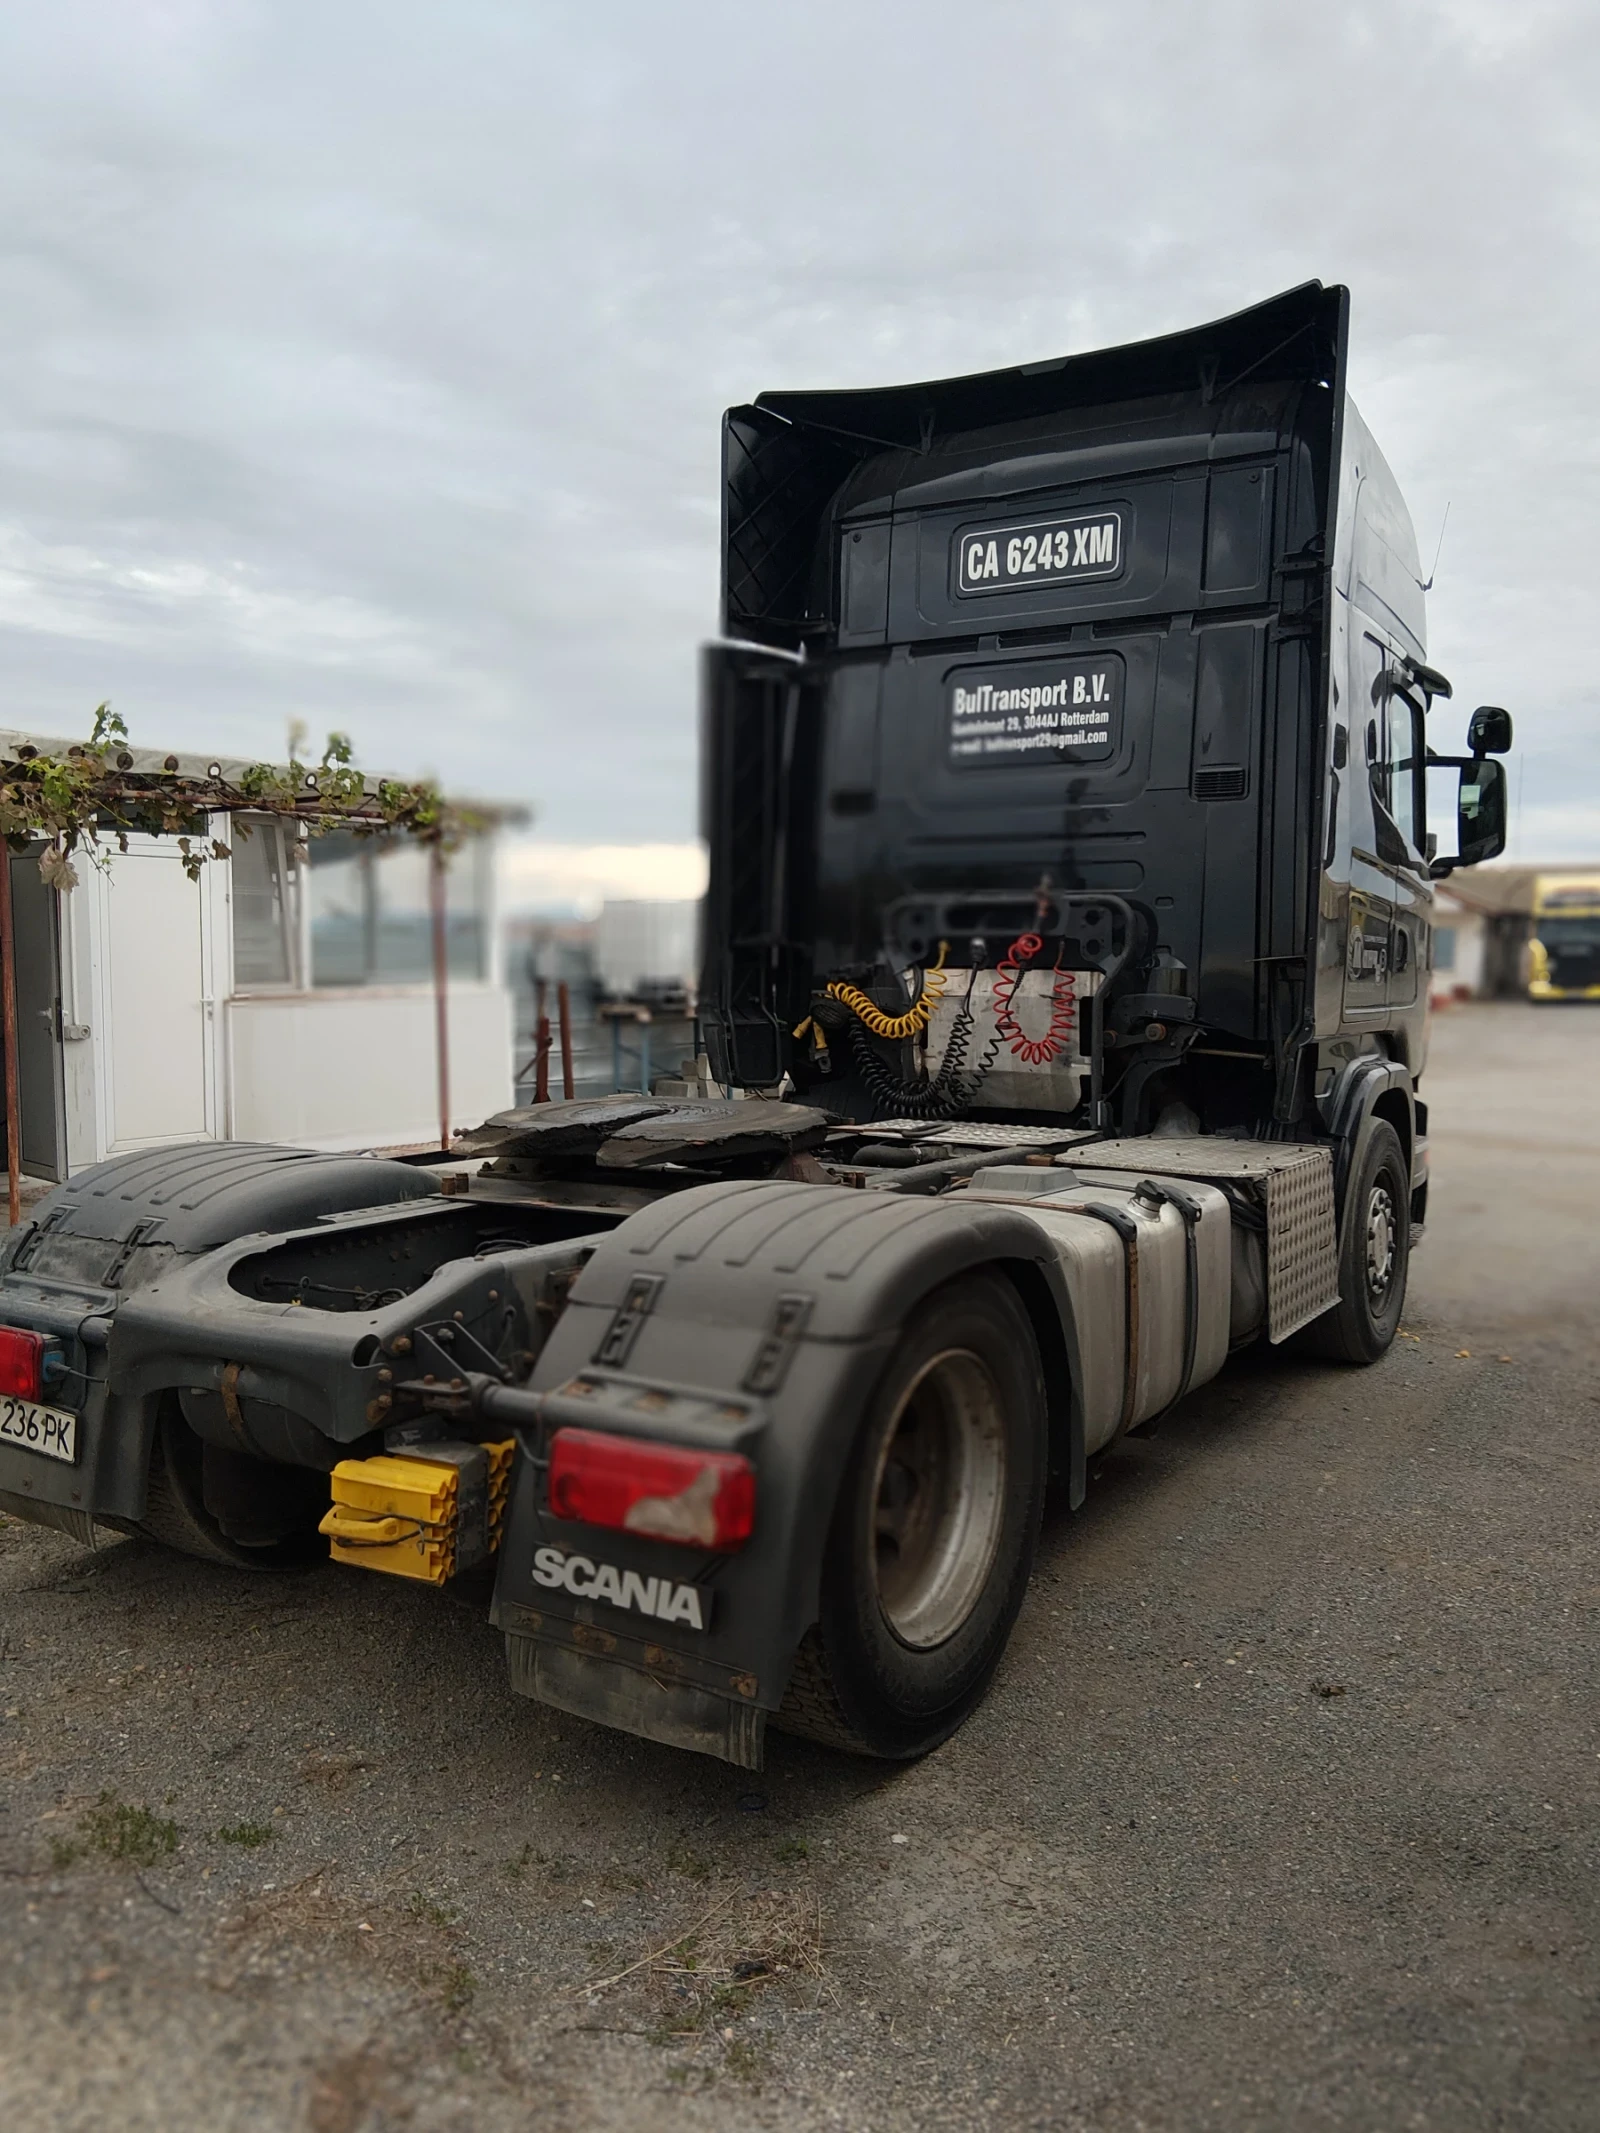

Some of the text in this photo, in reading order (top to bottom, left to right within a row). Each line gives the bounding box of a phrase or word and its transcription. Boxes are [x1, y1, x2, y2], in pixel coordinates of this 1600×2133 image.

[968, 540, 999, 580] CA
[1007, 531, 1069, 575] 6243
[955, 673, 1109, 715] BulTransport B.V.
[1024, 713, 1058, 729] 3044AJ
[1061, 710, 1109, 727] Rotterdam
[532, 1547, 703, 1629] SCANIA
